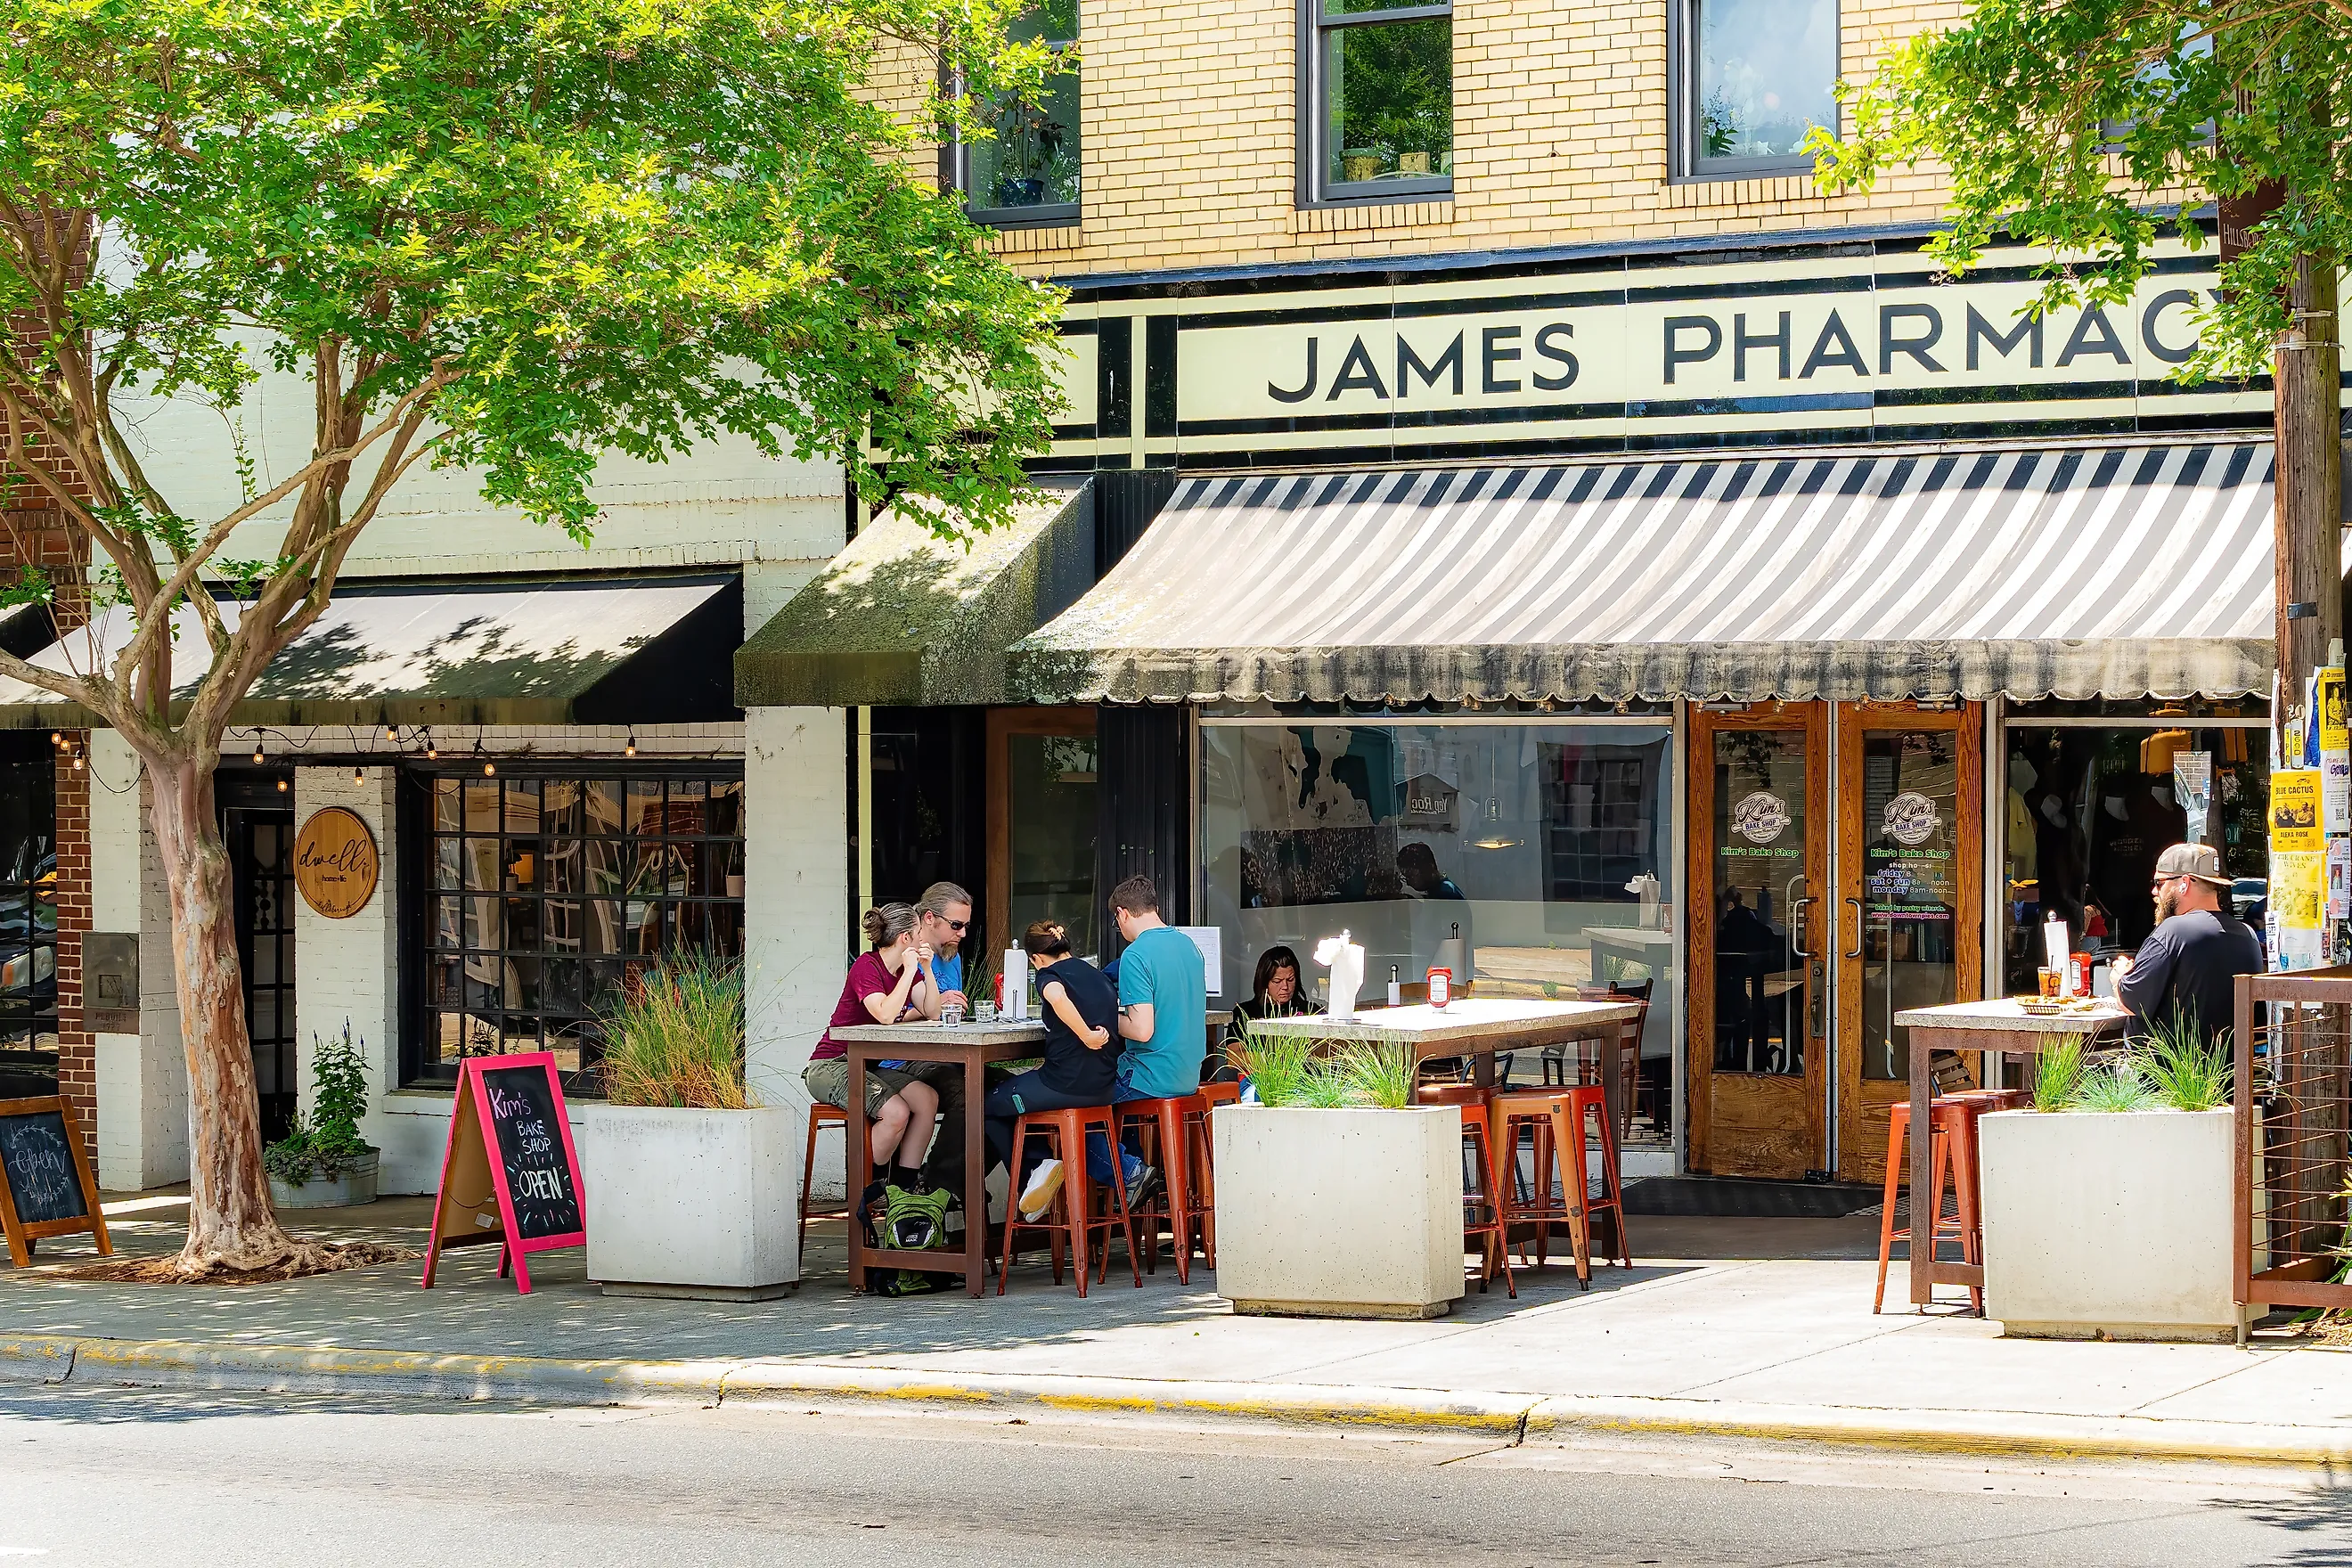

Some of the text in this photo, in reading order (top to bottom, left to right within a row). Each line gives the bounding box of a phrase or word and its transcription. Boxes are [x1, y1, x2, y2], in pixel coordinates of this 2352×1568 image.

[1268, 289, 2223, 403] JAMES PHARMAC
[2288, 785, 2314, 795] CACTUS
[1737, 797, 1783, 822] Kim's
[1887, 797, 1933, 823] Kim's
[1745, 819, 1776, 830] BAKE SHOP
[1895, 821, 1927, 830] BAKE SHOP
[1721, 846, 1799, 858] Kim's Bake Shop
[1871, 848, 1950, 861] Kim's Bake Shop
[1877, 870, 1905, 878] friday
[1893, 878, 1910, 886] sun
[1873, 886, 1908, 894] monday
[1871, 911, 1949, 919] www.downtownpies.com
[490, 1089, 532, 1120] Kim's
[516, 1120, 546, 1137] BAKE
[522, 1138, 551, 1155] SHOP
[519, 1167, 563, 1200] OPEN
